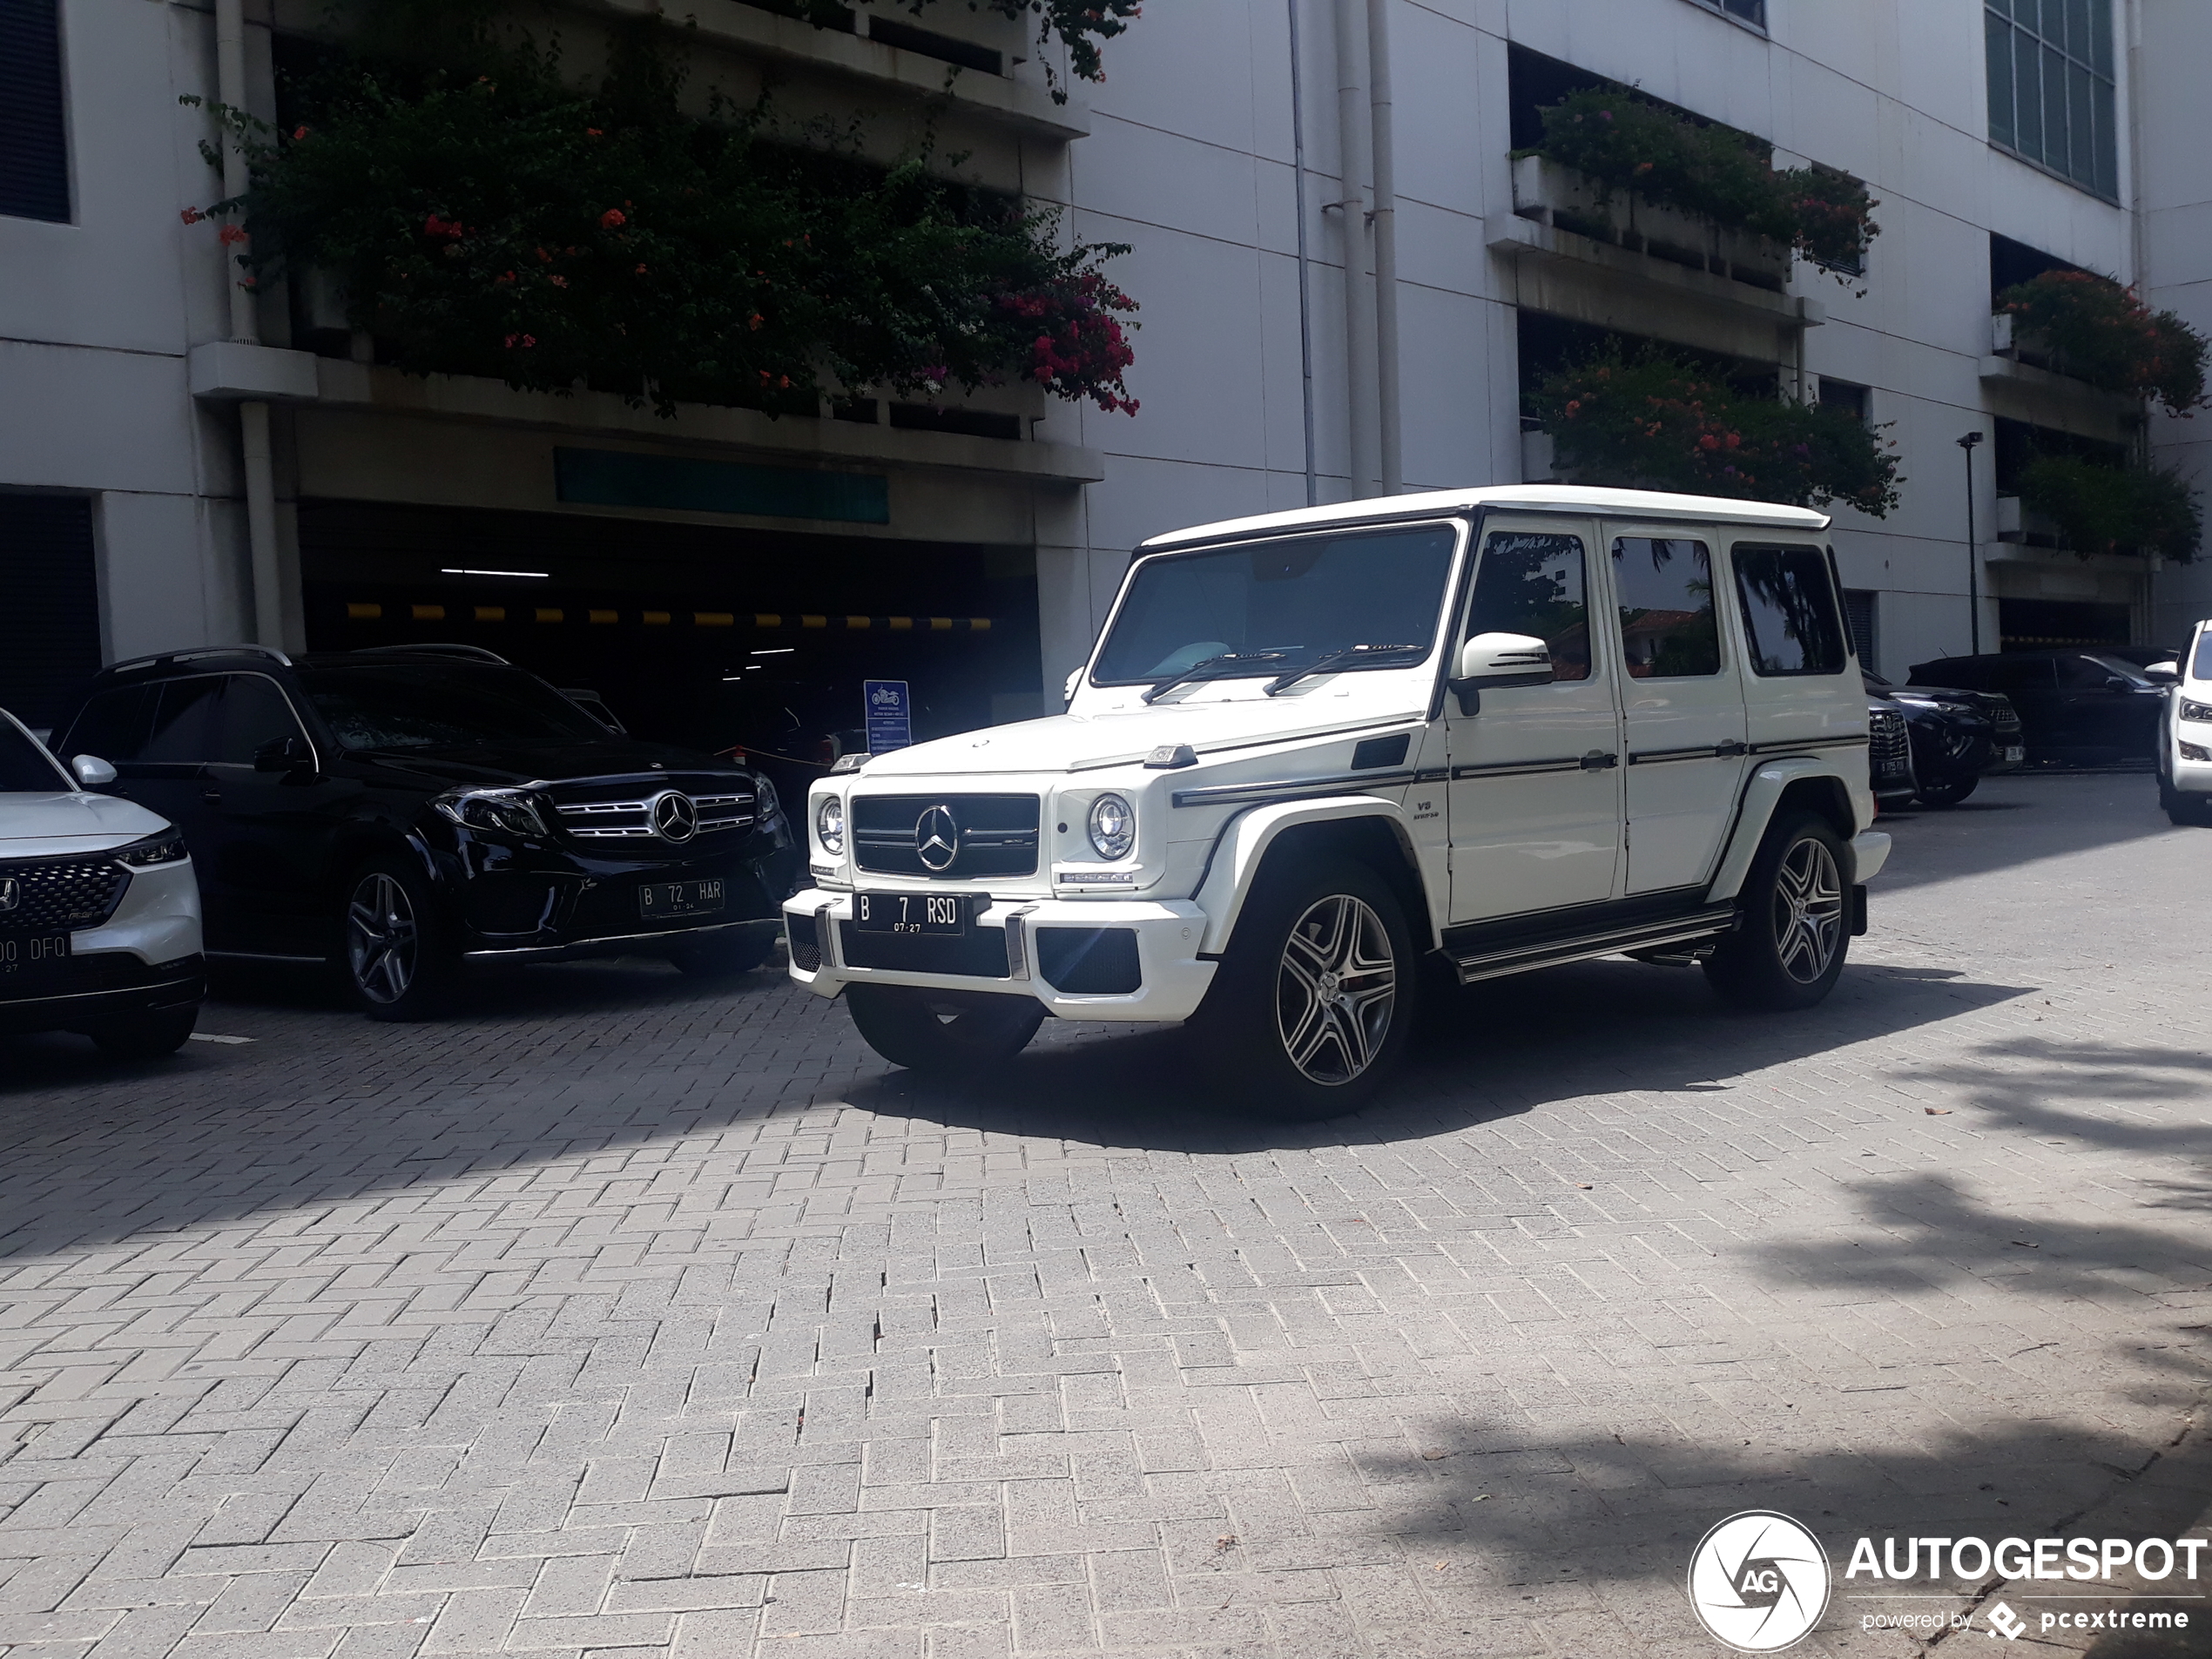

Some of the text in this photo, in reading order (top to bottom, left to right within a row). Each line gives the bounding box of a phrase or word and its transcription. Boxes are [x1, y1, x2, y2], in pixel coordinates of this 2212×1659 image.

[644, 881, 721, 906] B 72 HAR
[860, 895, 956, 924] B 7 RSD
[30, 936, 65, 960] DFQ
